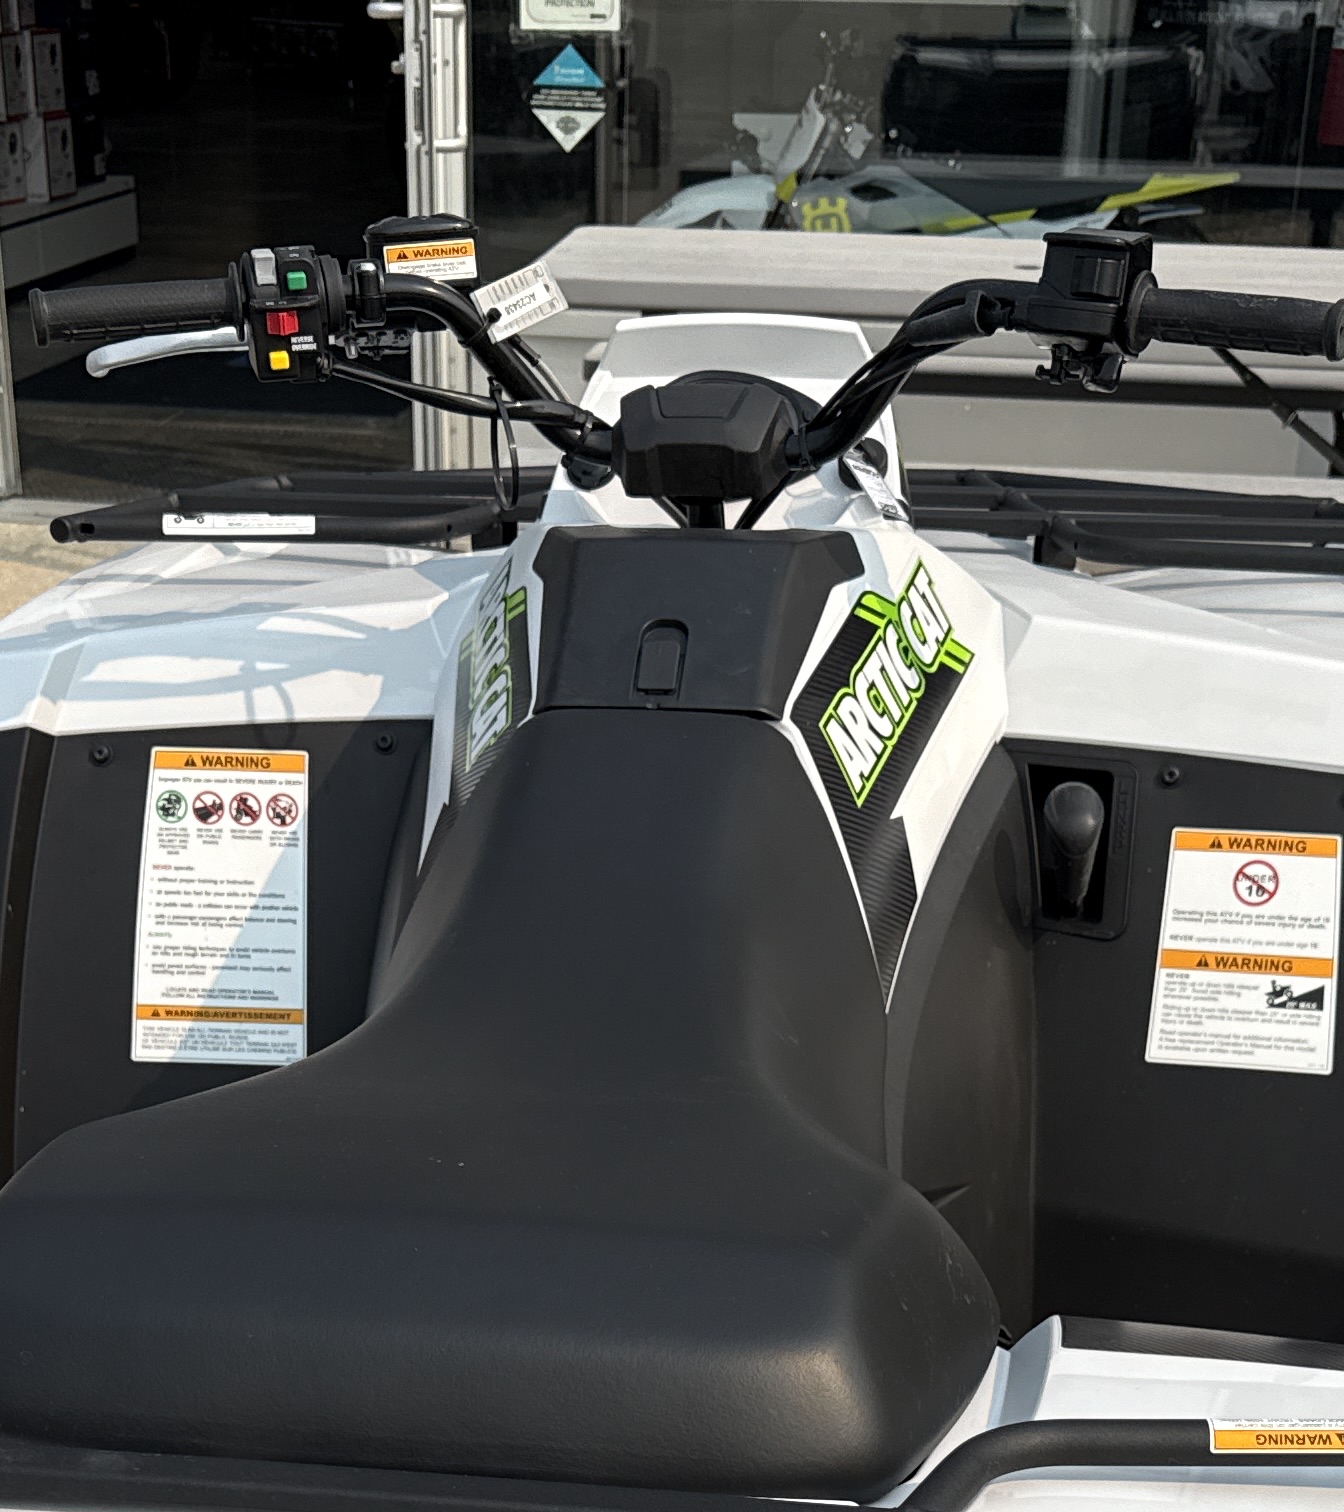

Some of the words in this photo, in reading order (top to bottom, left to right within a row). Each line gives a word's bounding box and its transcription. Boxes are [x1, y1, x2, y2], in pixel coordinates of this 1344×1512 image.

[412, 246, 468, 258] WARNING
[823, 620, 922, 797] ARCTIC
[898, 562, 951, 666] CAT
[469, 670, 508, 762] CAT
[201, 755, 272, 770] WARNING
[1228, 837, 1307, 853] WARNING
[1215, 956, 1294, 973] WARNING
[1256, 1434, 1333, 1446] WARNING
